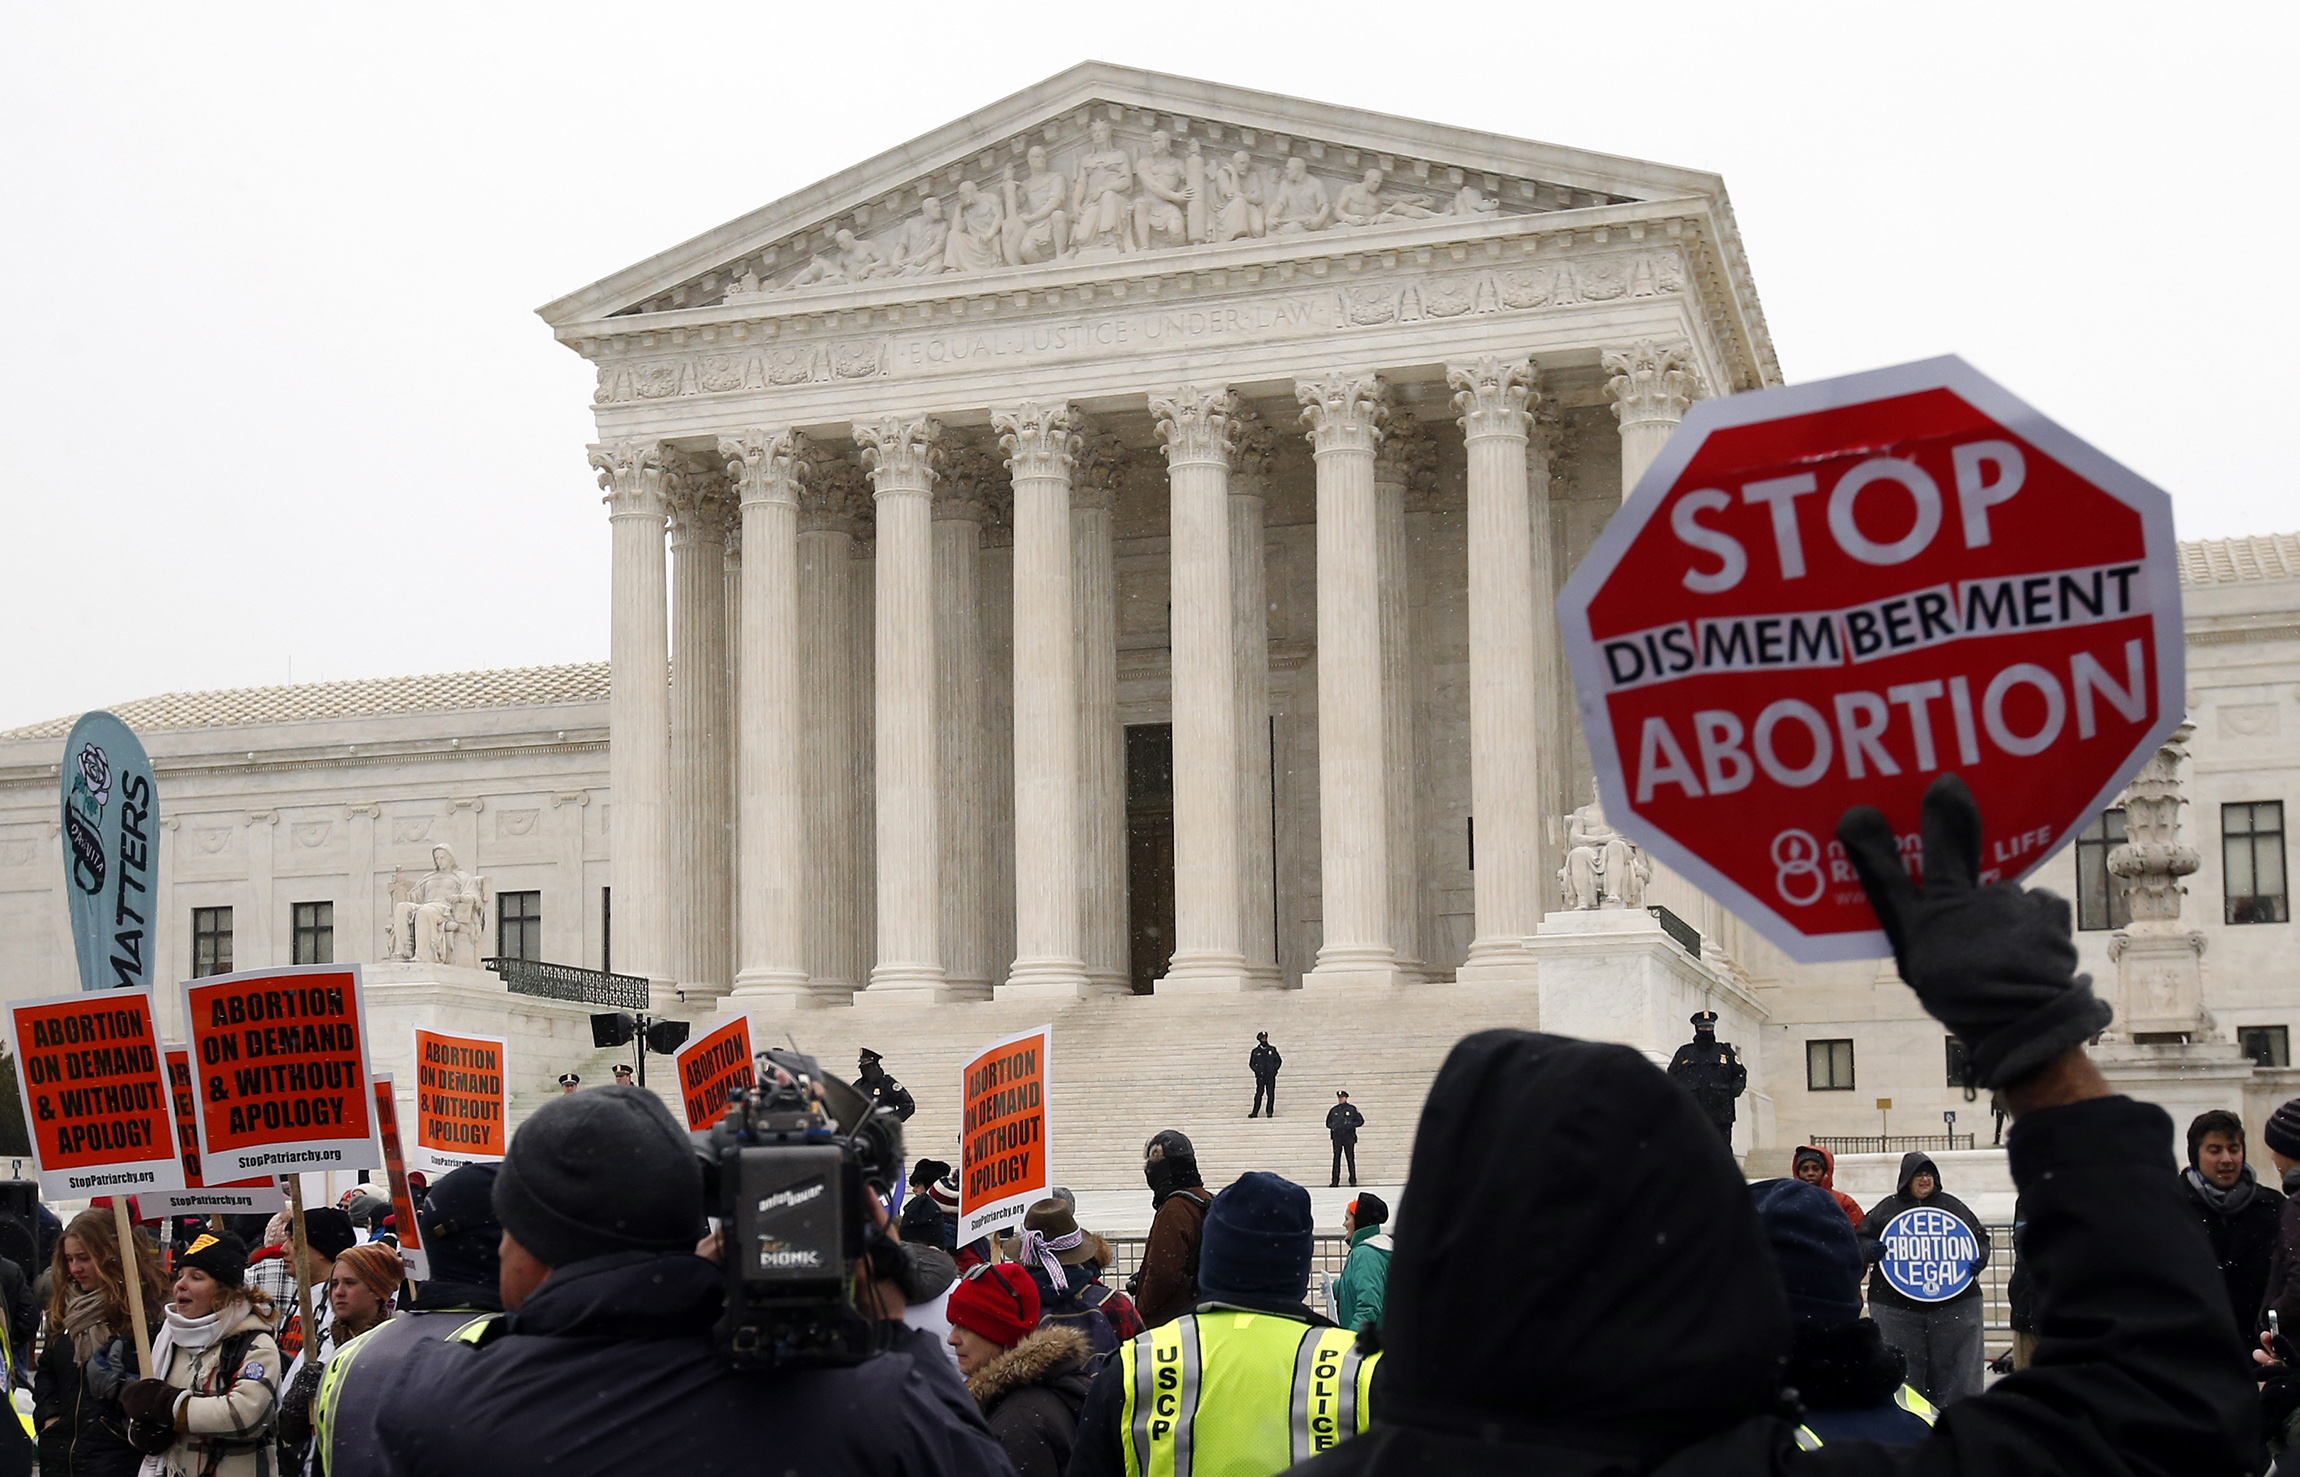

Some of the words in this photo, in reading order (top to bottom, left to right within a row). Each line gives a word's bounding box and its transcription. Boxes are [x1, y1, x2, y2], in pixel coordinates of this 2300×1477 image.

[910, 335, 1005, 364] EQUAL
[1013, 321, 1128, 353] JUSTICE
[1144, 309, 1244, 338] UNDER
[1256, 301, 1314, 328] LAW
[1670, 440, 2026, 594] STOP
[1635, 638, 2148, 803] ABORTION
[1994, 825, 2051, 862] LIFE
[211, 987, 344, 1027] ABORTION
[33, 1009, 143, 1048] ABORTION
[203, 1033, 238, 1065] ON
[245, 1023, 354, 1058] DEMAND
[29, 1055, 61, 1084] ON
[65, 1045, 154, 1080] DEMAND
[426, 1041, 495, 1070] ABORTION
[686, 1032, 744, 1091] ABORTION
[969, 1049, 1036, 1101] ABORTION
[209, 1076, 229, 1102] &
[234, 1061, 356, 1097] WITHOUT
[420, 1065, 435, 1087] ON
[439, 1069, 499, 1095] DEMAND
[37, 1095, 56, 1121] &
[59, 1082, 158, 1118] WITHOUT
[230, 1097, 344, 1135] APOLOGY
[421, 1093, 429, 1112] &
[432, 1094, 500, 1121] WITHOUT
[688, 1094, 706, 1125] ON
[965, 1106, 976, 1136] ON
[979, 1081, 1040, 1126] DEMAND
[58, 1118, 152, 1154] APOLOGY
[429, 1119, 490, 1145] APOLOGY
[965, 1146, 972, 1170] &
[973, 1116, 1041, 1165] WITHOUT
[239, 1149, 342, 1168] StopPatriarchy.org
[970, 1152, 1030, 1200] APOLOGY
[69, 1172, 154, 1188] StopPatriarchy.org
[170, 1194, 252, 1207] StopPatriarchy.org
[971, 1204, 1024, 1231] StopPatriarchy.org
[1898, 1211, 1957, 1235] KEEP
[1885, 1236, 1973, 1261] ABORTION
[1894, 1261, 1966, 1285] LEGAL
[1152, 1346, 1177, 1440] USCP
[1312, 1350, 1338, 1451] POLICE
